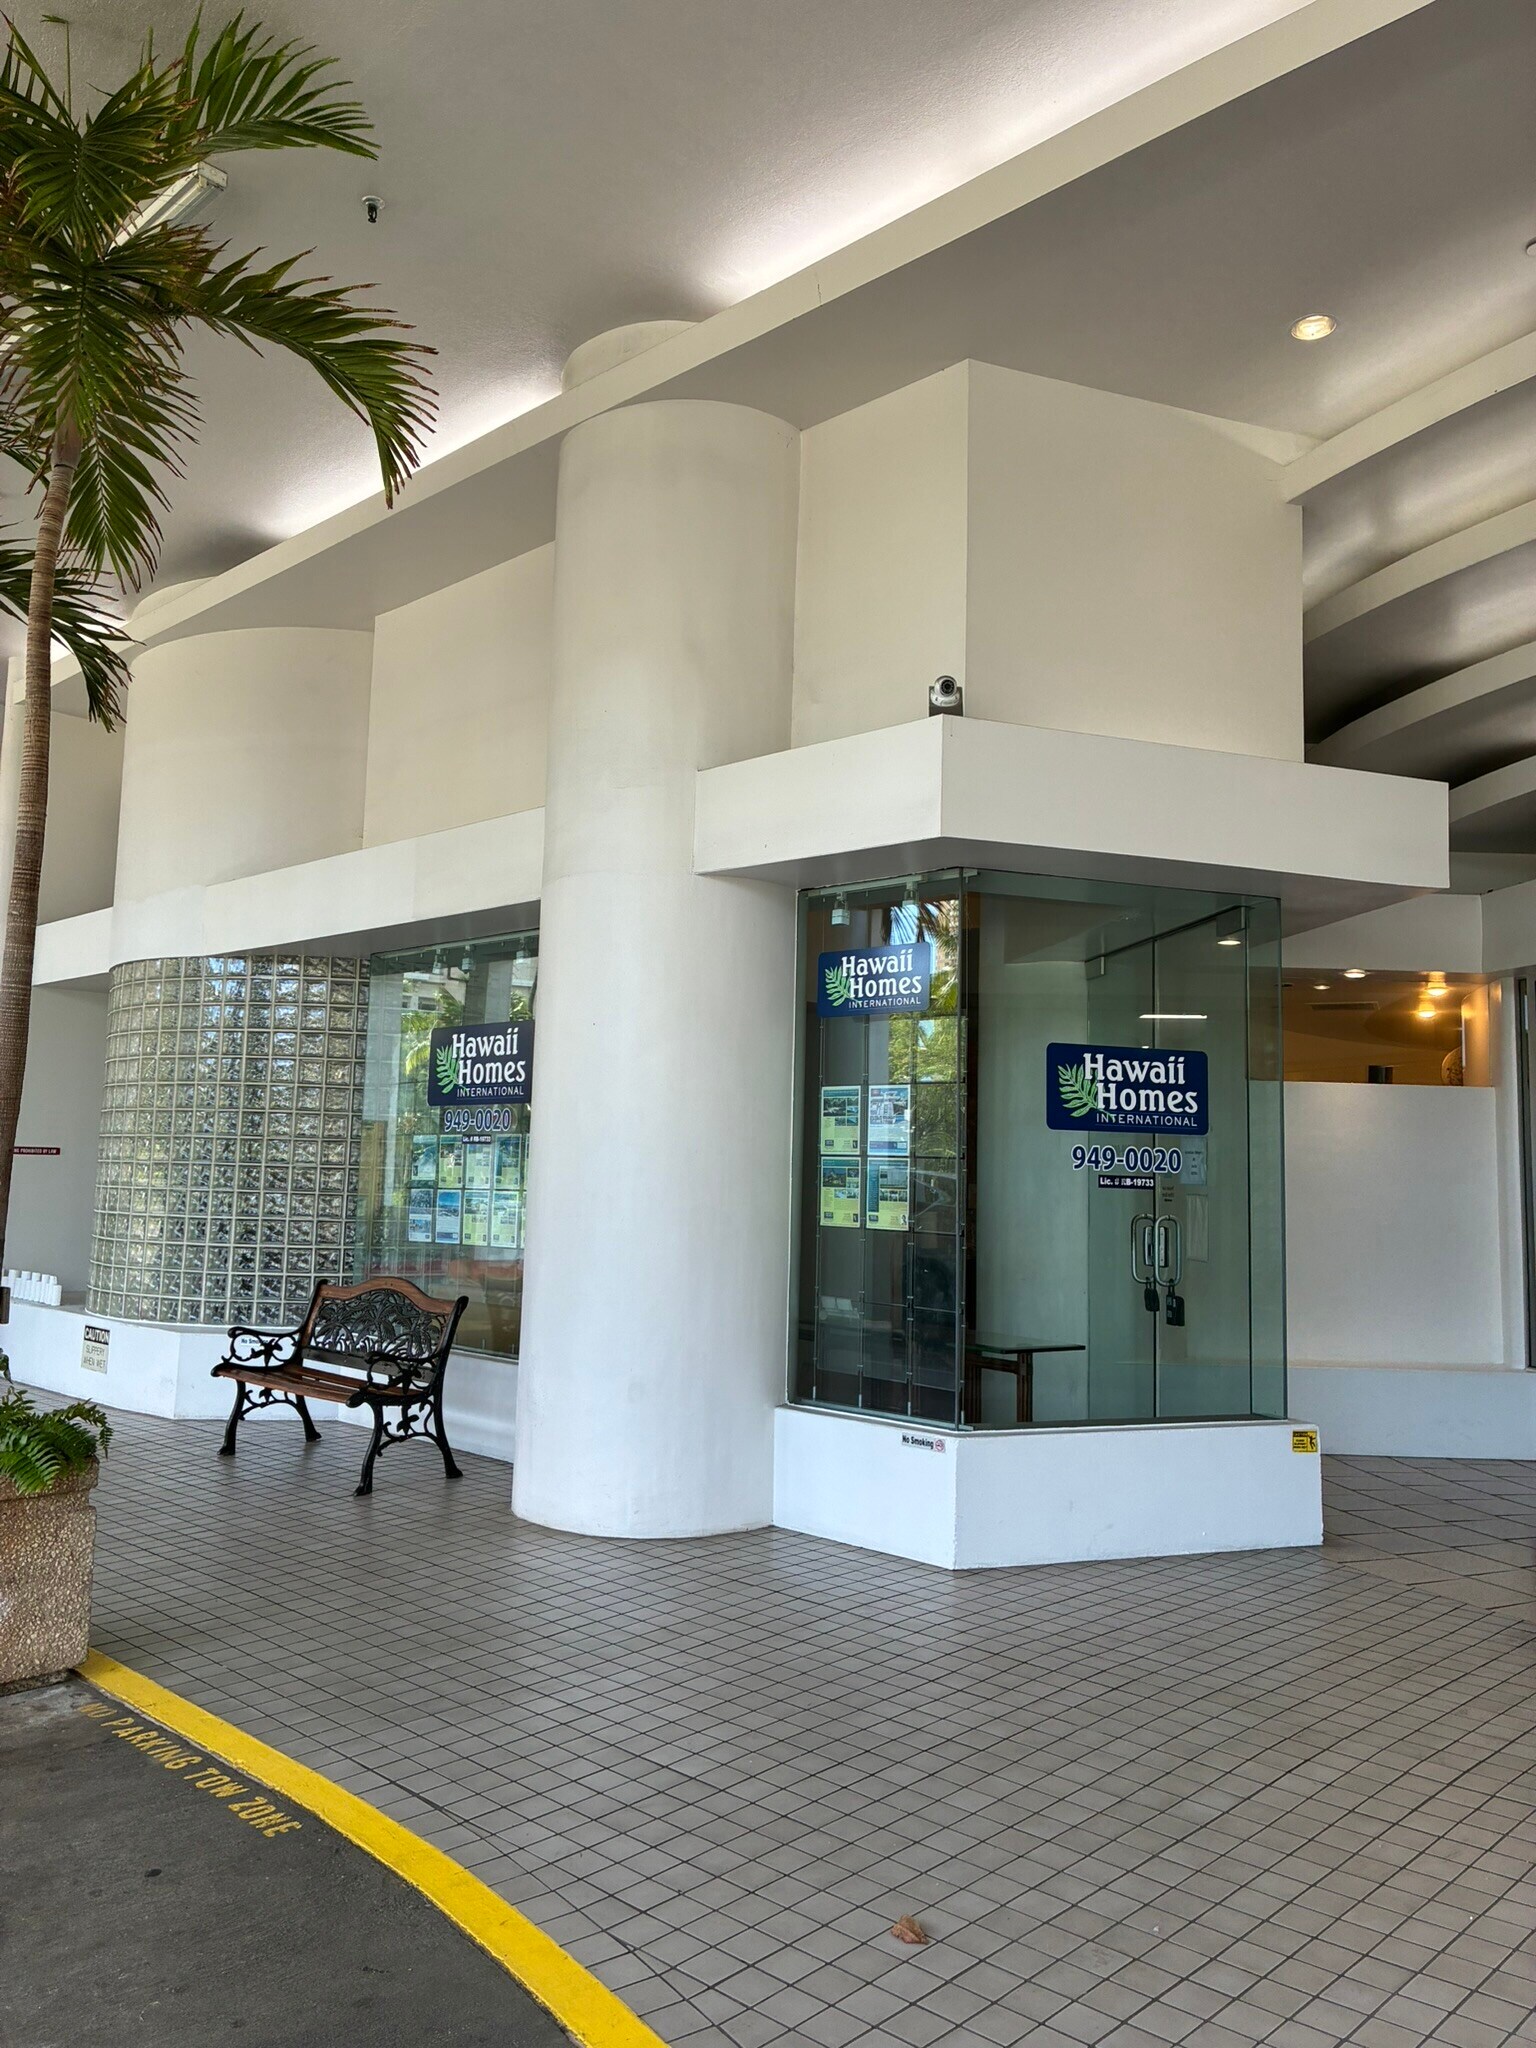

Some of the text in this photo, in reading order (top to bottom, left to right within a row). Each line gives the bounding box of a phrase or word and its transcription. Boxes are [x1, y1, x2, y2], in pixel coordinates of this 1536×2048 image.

[841, 948, 914, 977] Hawaii
[849, 975, 922, 998] Homes
[848, 996, 921, 1009] INTERNATIONAL
[452, 1027, 519, 1059] Hawaii
[458, 1059, 526, 1085] Homes
[1083, 1052, 1186, 1085] Hawaii
[456, 1086, 524, 1098] INTERNATIONAL
[1096, 1082, 1198, 1114] Homes
[444, 1108, 512, 1132] 949-0020
[1096, 1113, 1198, 1127] INTERNATIONAL
[1071, 1144, 1183, 1174] 949-0020
[1100, 1176, 1113, 1186] Lic.
[84, 1326, 110, 1344] CAUTION
[902, 1435, 934, 1450] No Smoking
[77, 1702, 302, 1838] NO PARKING TOW ZONE
